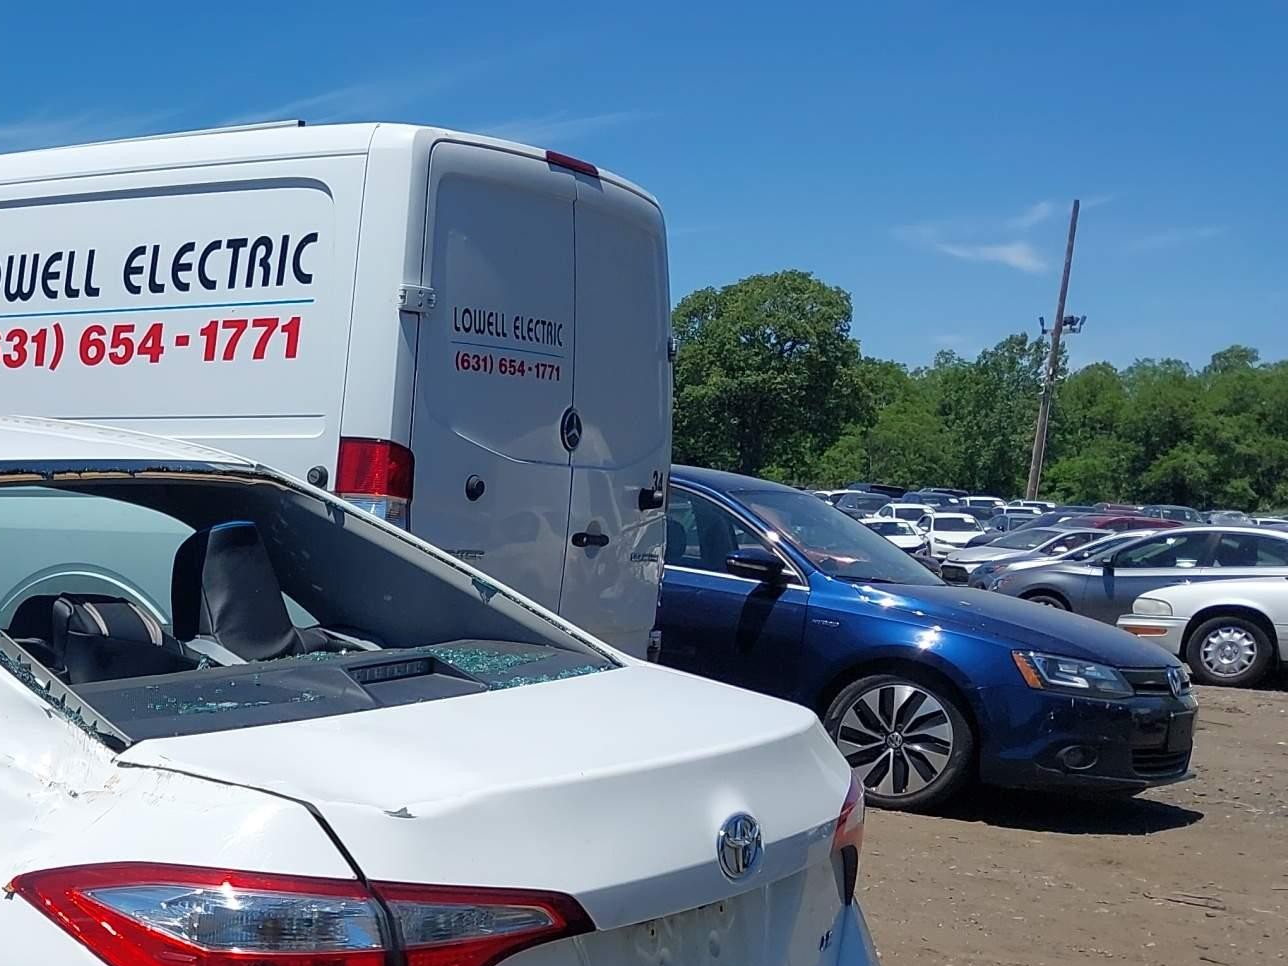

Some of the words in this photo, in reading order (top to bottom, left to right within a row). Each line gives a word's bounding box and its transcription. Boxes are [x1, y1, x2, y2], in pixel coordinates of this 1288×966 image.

[123, 232, 319, 295] ELECTRIC
[453, 307, 507, 338] LOWELL
[513, 316, 563, 347] ELECTRIC
[455, 351, 493, 374] (631)
